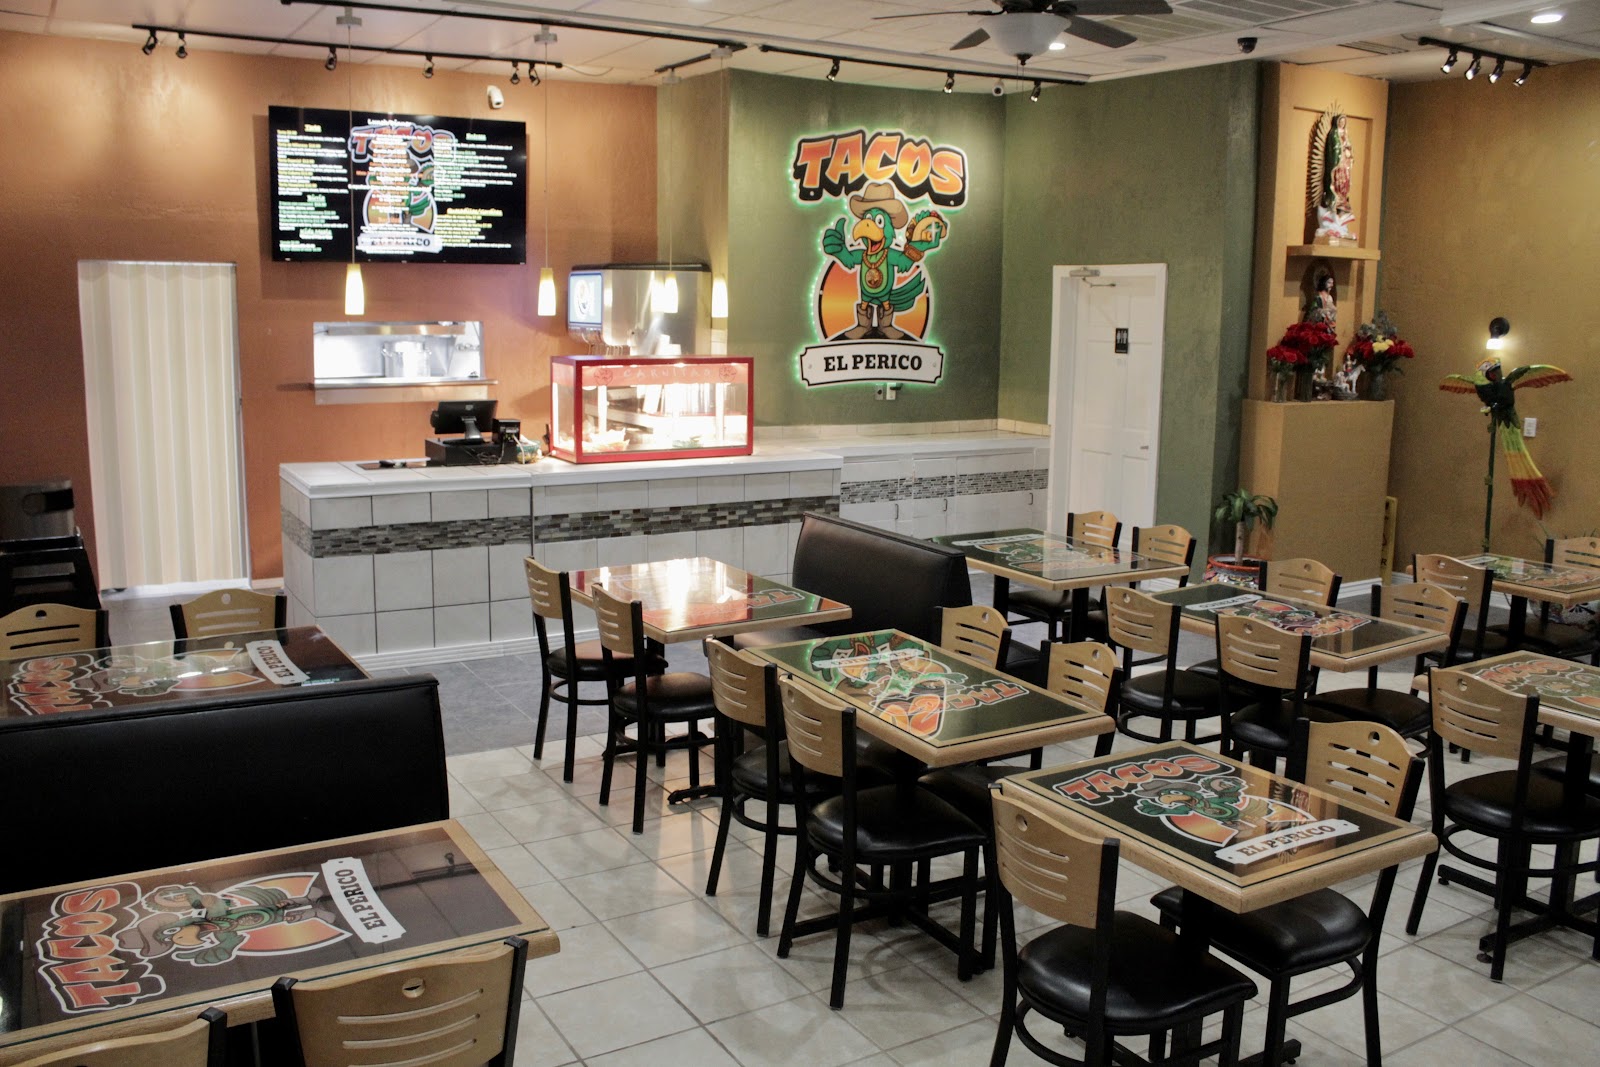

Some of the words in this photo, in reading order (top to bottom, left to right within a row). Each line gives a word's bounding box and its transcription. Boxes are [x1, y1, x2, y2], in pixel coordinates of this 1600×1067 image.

[797, 131, 965, 198] TACOS
[823, 355, 848, 373] EL
[851, 353, 923, 372] PERICO
[1061, 756, 1223, 802] TACOS
[1236, 844, 1269, 858] EL
[1260, 825, 1337, 849] PERICO
[334, 868, 374, 914] PERICO
[359, 911, 387, 931] EL
[48, 884, 141, 1009] TACOS
